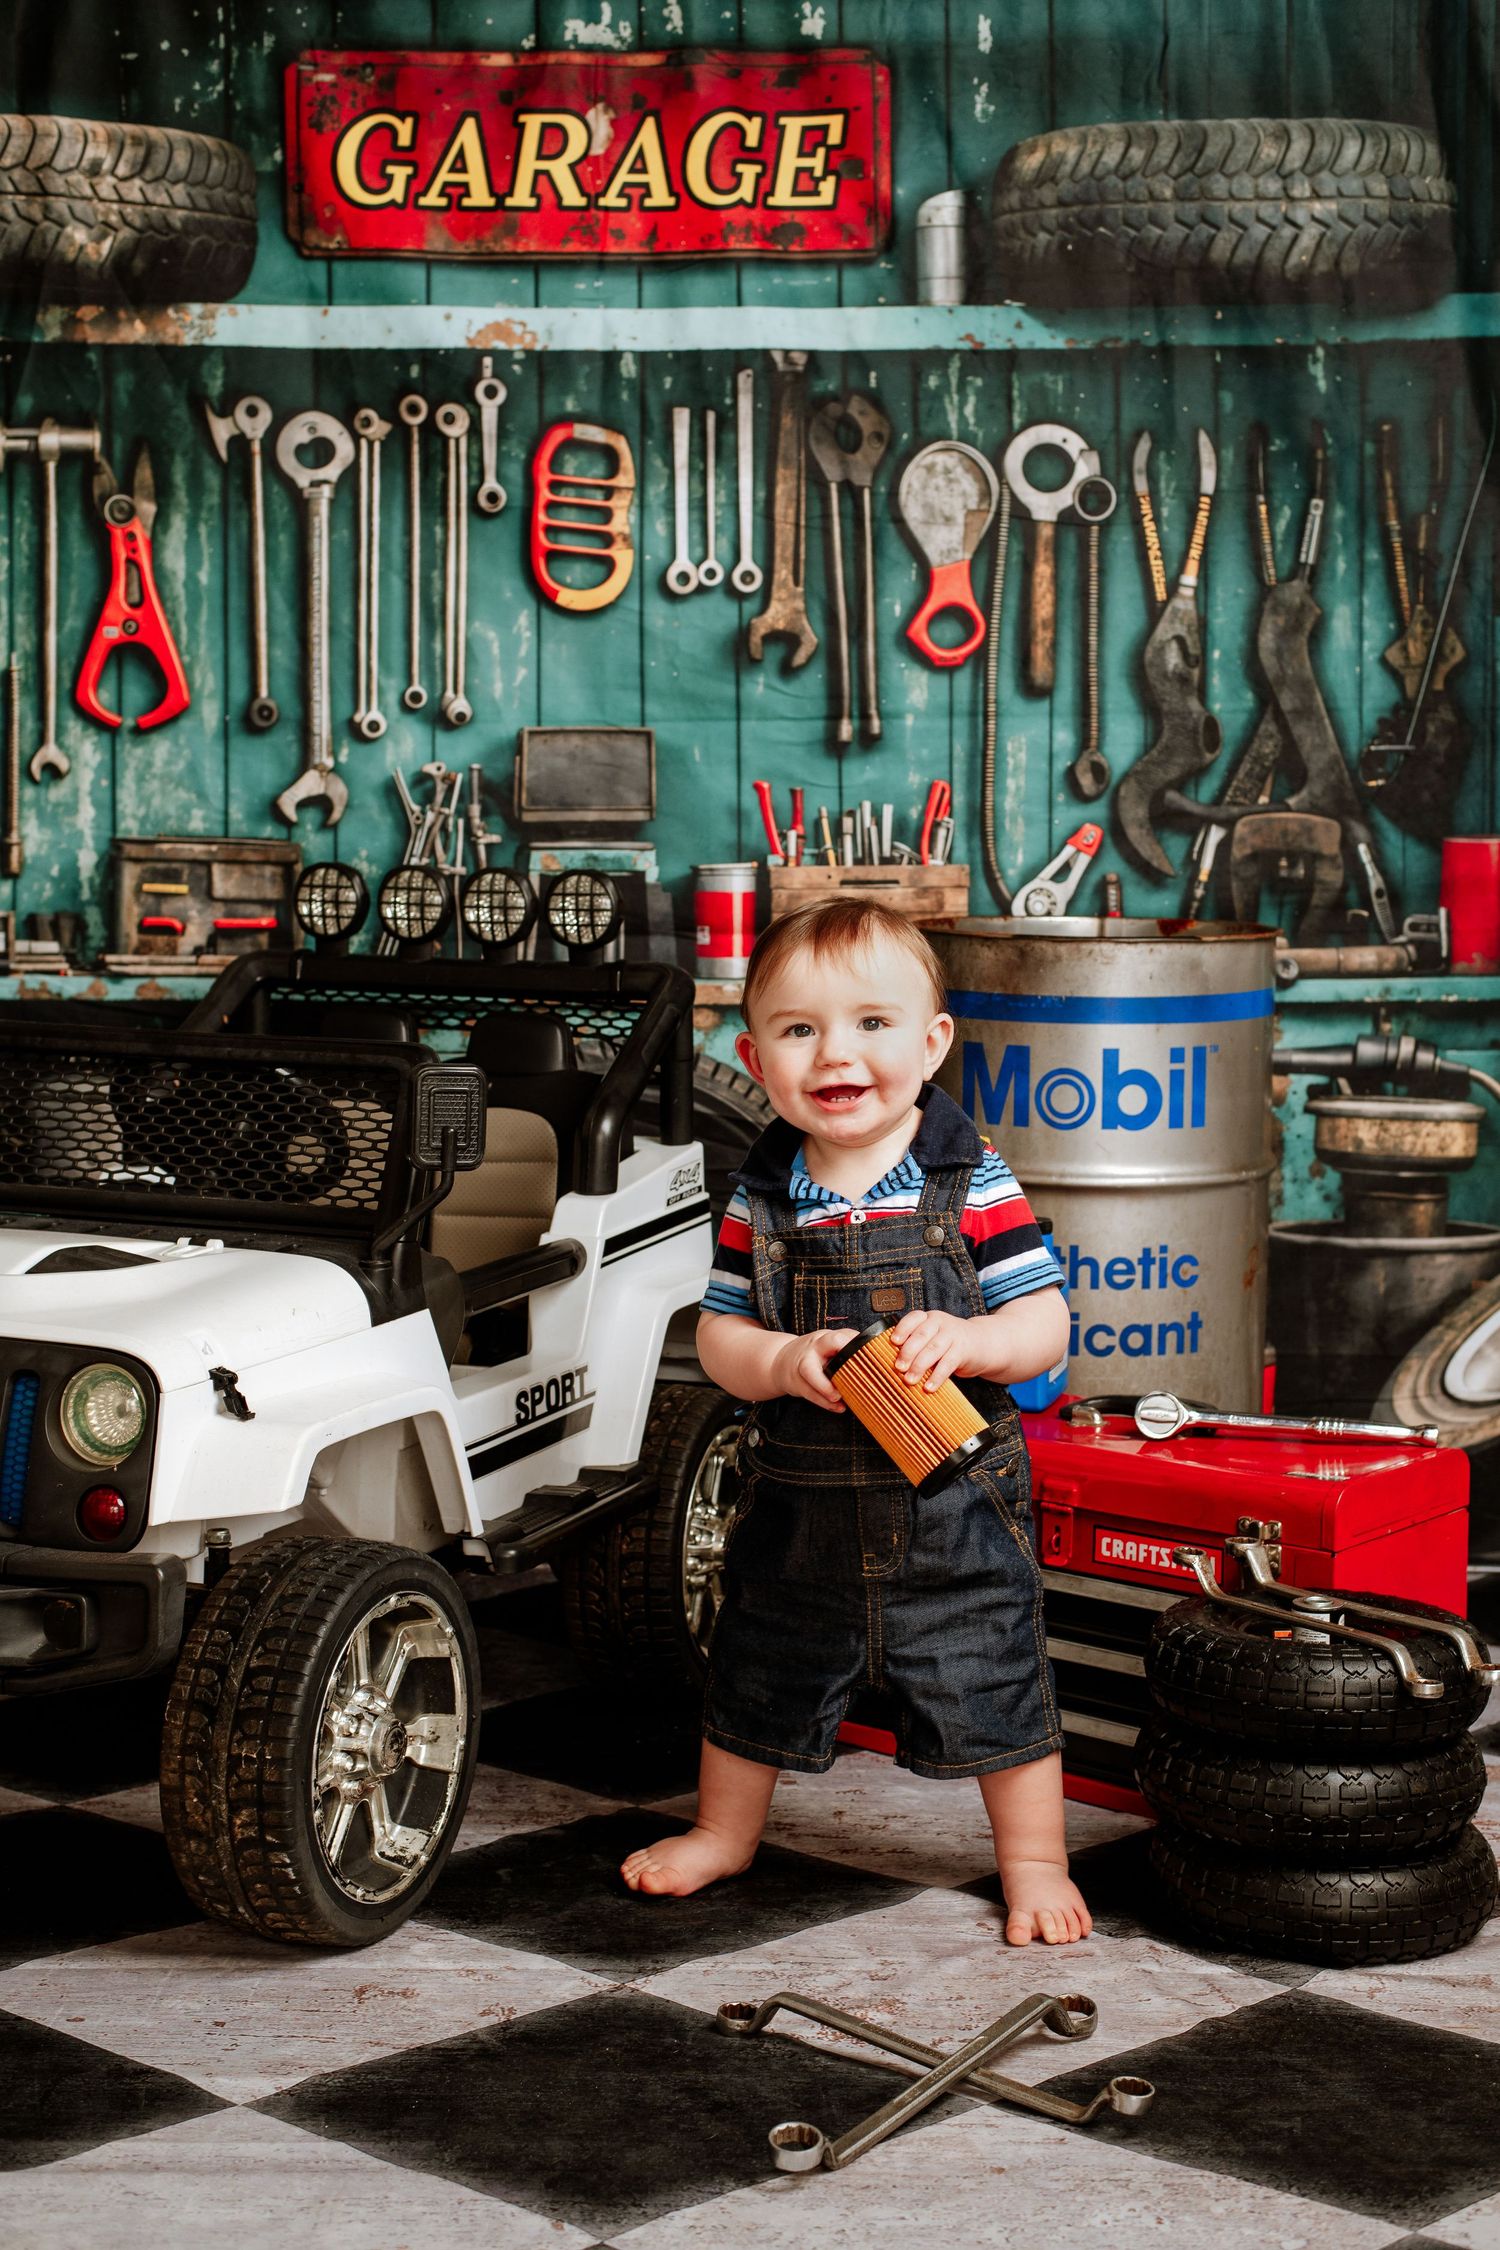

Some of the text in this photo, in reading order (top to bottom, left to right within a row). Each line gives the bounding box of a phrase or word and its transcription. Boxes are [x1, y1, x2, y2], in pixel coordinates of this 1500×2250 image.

[333, 109, 848, 211] GARAGE
[962, 1041, 1207, 1131] Mobil
[875, 1293, 899, 1306] Lee
[515, 1365, 588, 1427] SPORT
[1101, 1537, 1216, 1577] CRAFTS
